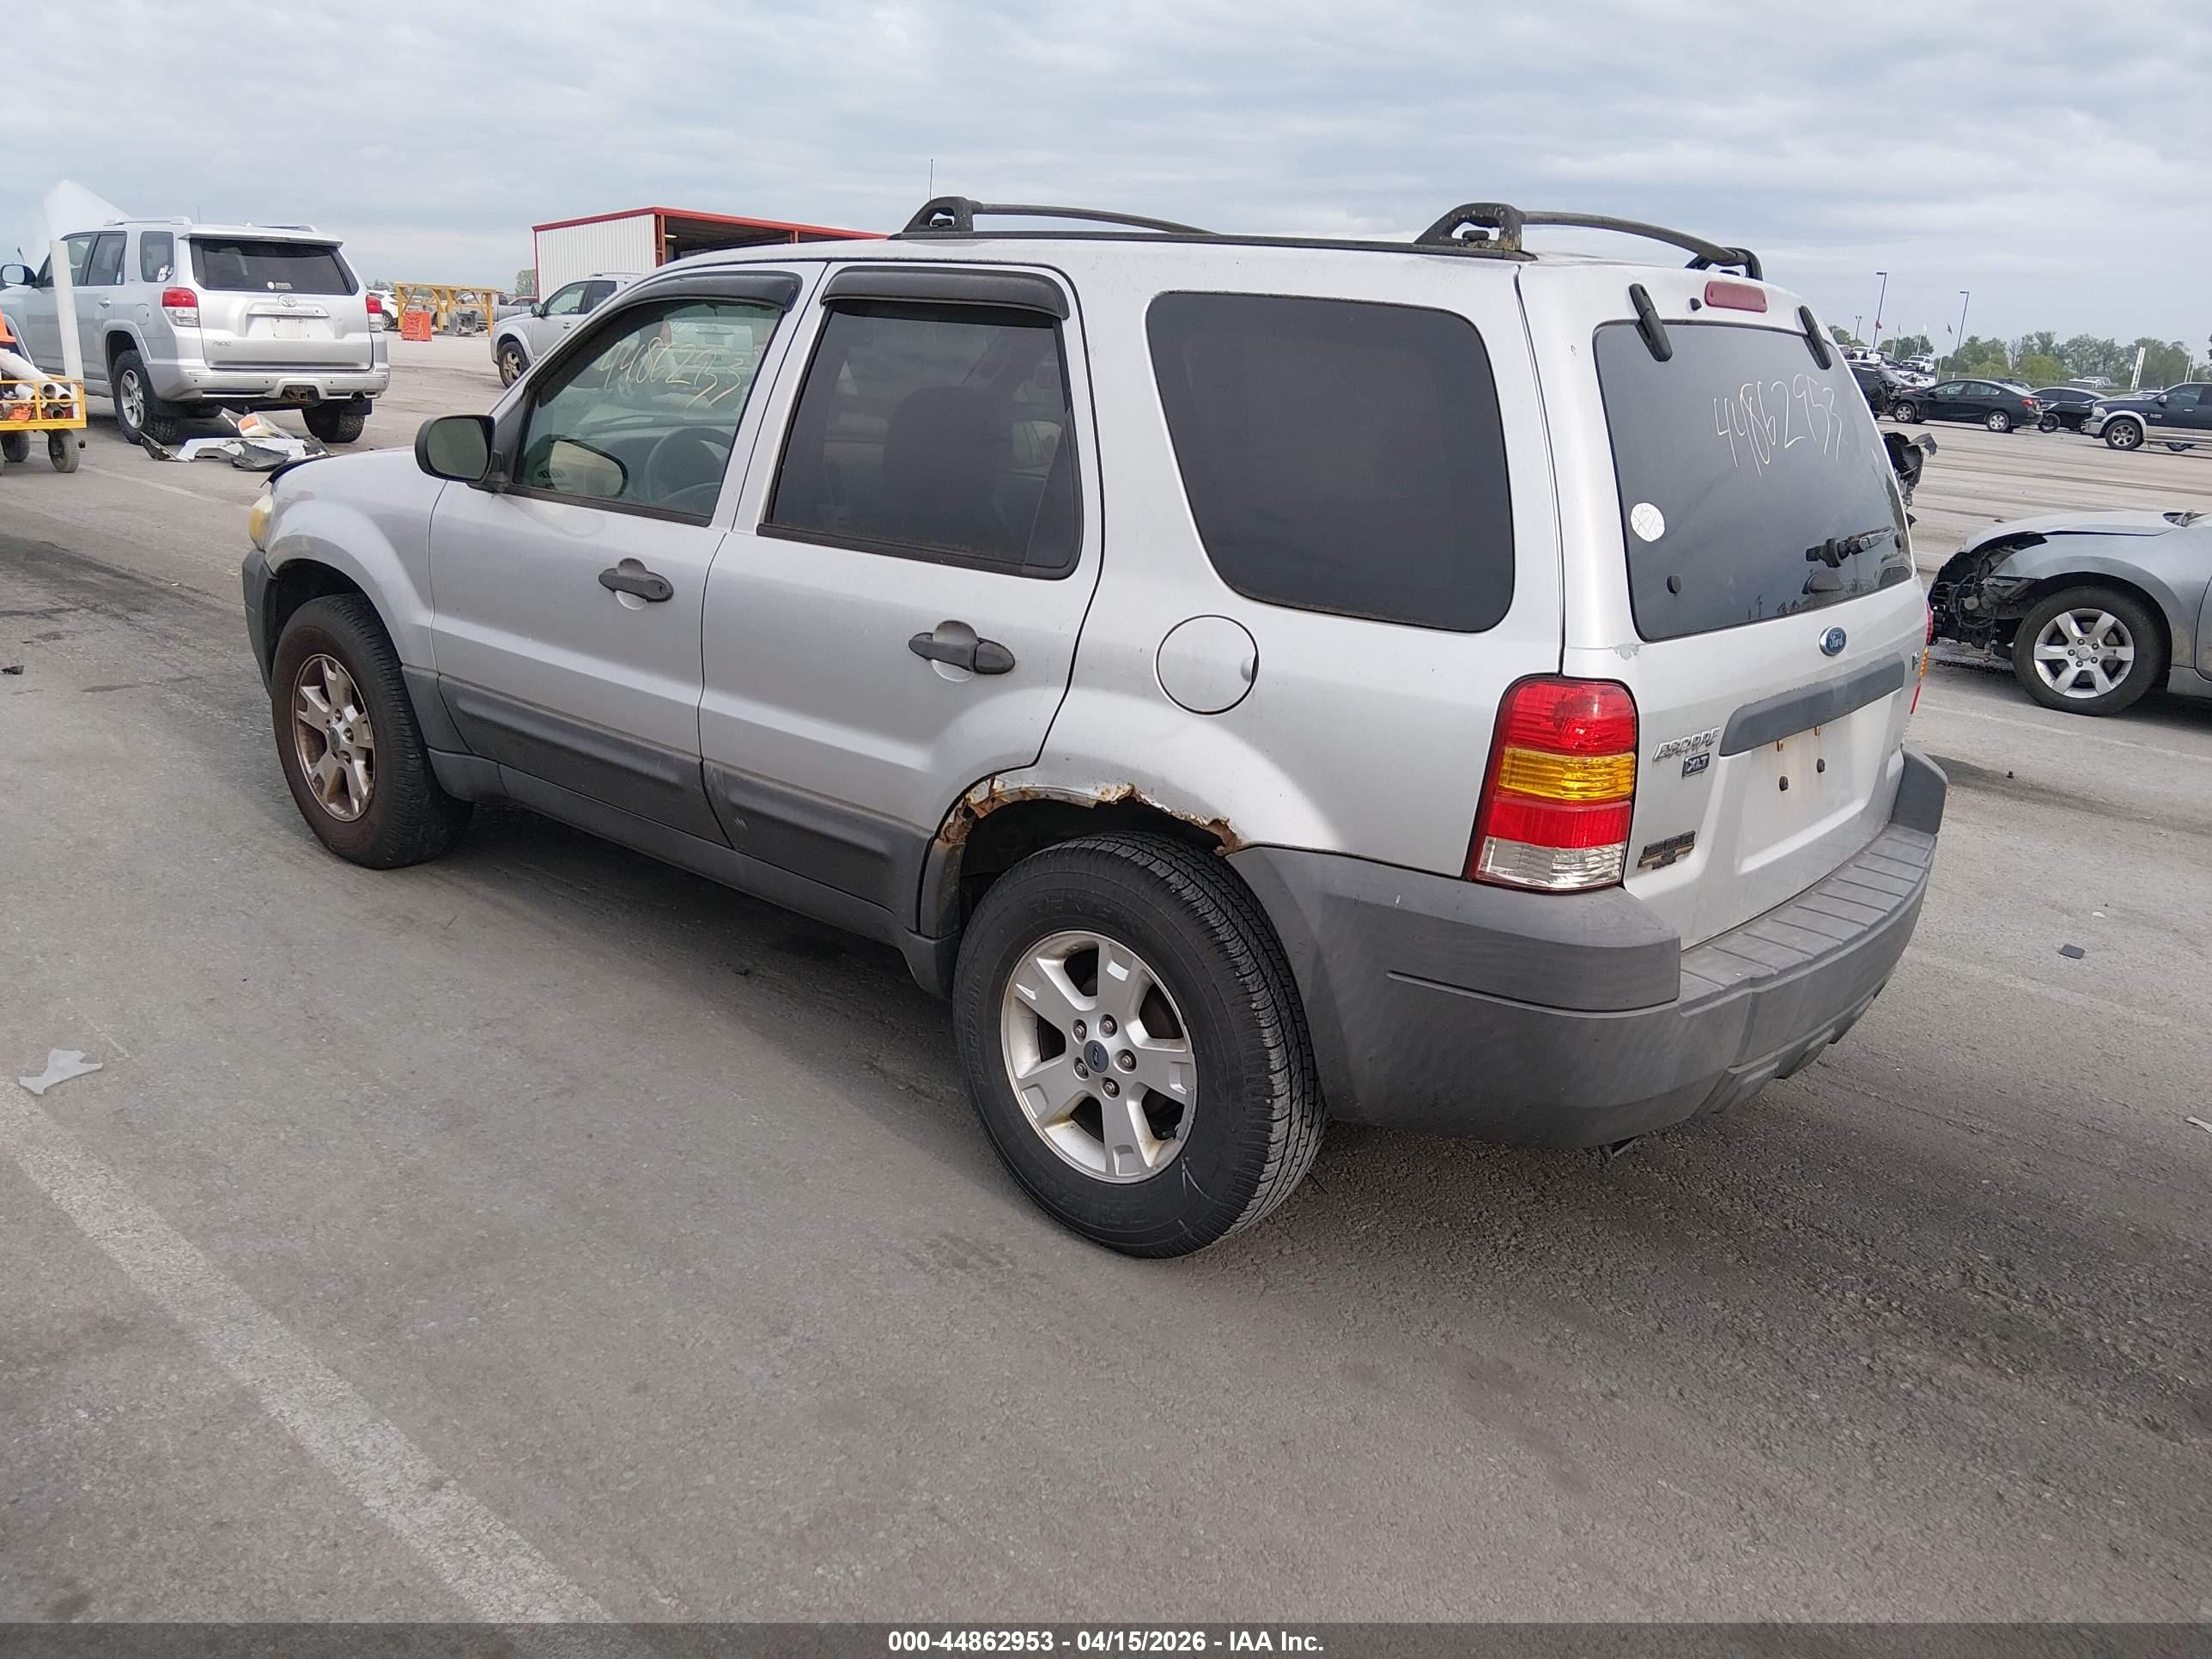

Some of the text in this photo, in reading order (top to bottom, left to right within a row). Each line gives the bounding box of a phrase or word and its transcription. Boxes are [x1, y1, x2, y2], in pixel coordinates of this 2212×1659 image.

[1713, 373, 1843, 477] 44862953
[1651, 726, 1721, 763] ESCAPE
[1686, 754, 1709, 773] XLT
